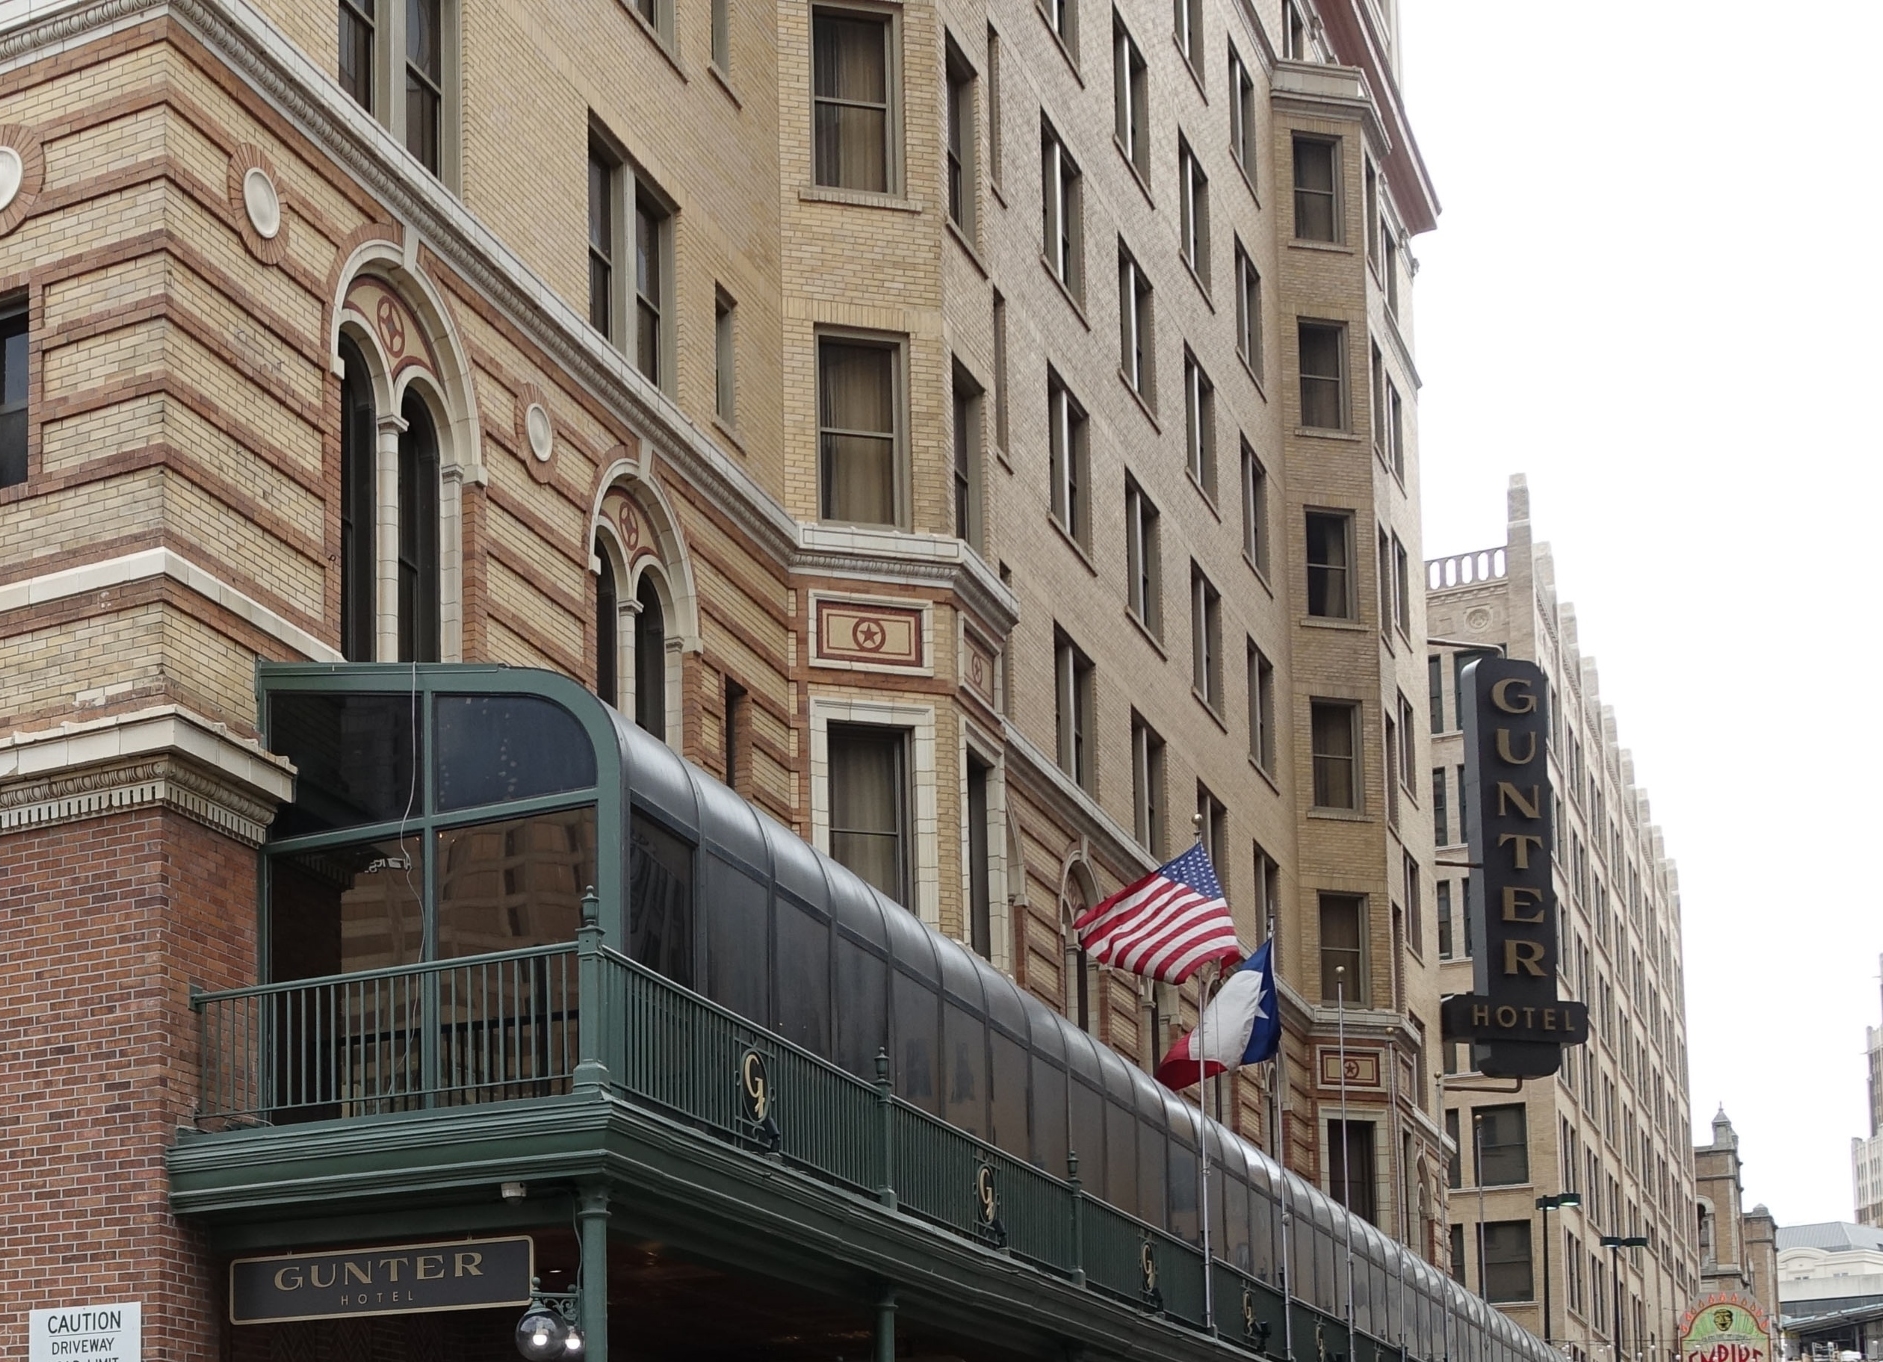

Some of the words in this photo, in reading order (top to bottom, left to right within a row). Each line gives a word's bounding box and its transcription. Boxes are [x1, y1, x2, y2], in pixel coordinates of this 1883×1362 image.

[1490, 678, 1548, 978] GUNTER
[1471, 1004, 1576, 1032] HOTEL
[273, 1251, 484, 1292] GUNTER
[340, 1289, 414, 1306] HOTEL
[47, 1310, 122, 1334] CAUTION
[51, 1337, 115, 1355] DRIVEWAY
